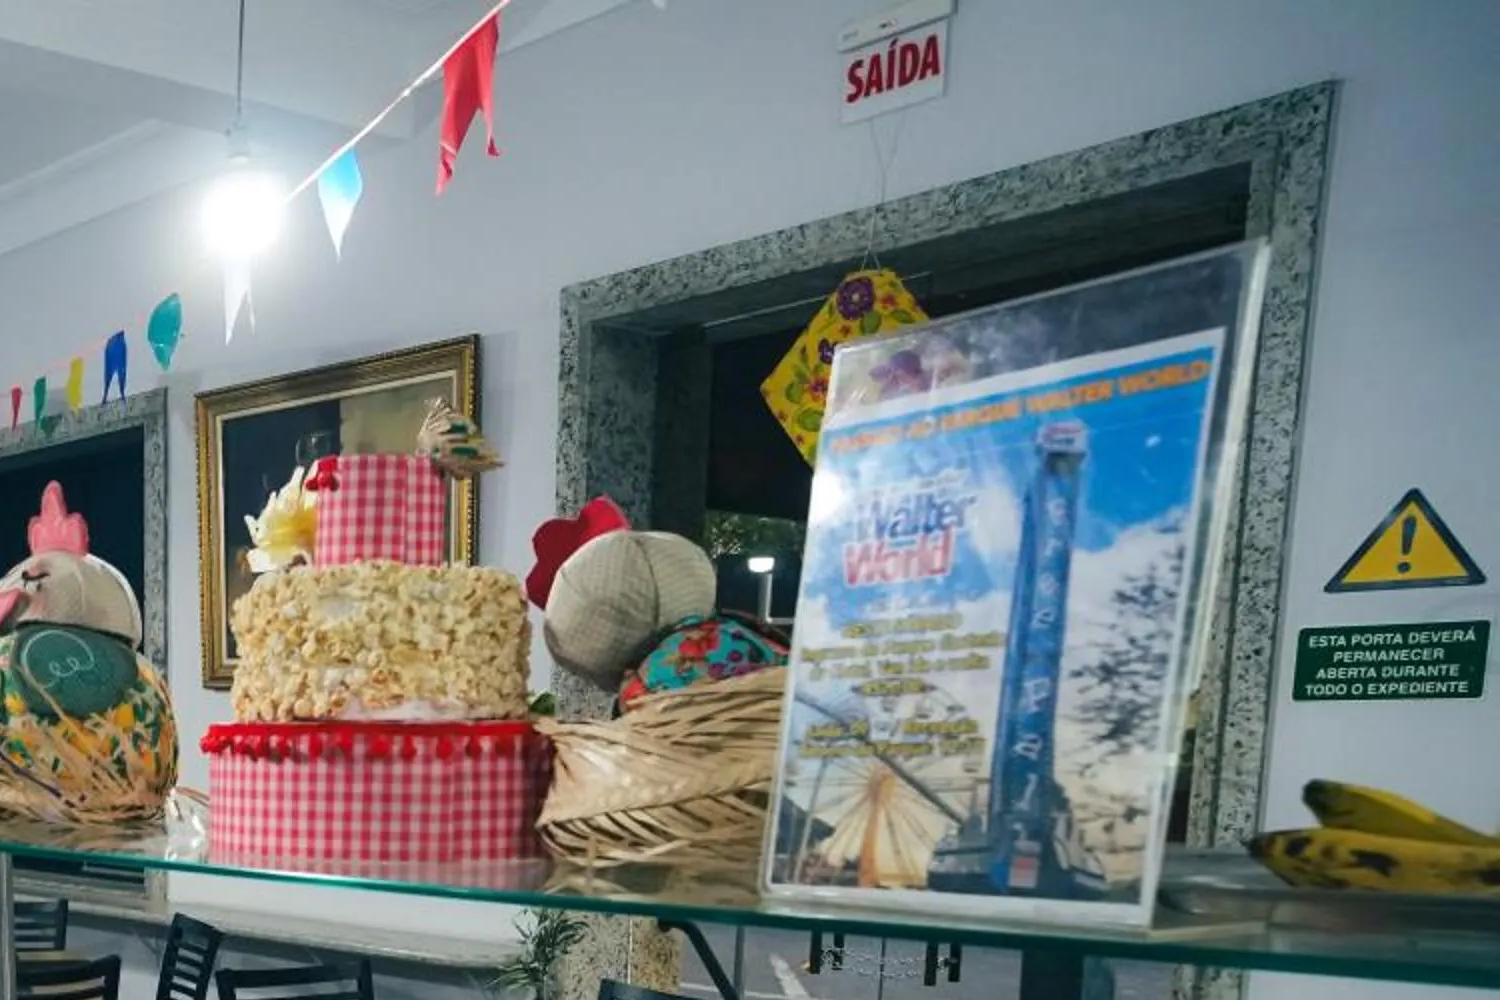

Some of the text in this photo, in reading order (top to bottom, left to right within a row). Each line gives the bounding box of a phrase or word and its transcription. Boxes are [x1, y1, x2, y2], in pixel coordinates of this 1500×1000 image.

[846, 32, 940, 104] SAÍDA
[844, 525, 953, 587] World
[1308, 626, 1477, 649] ESTA PORTA DEVERÁ
[1333, 647, 1445, 663] PERMANECER
[1316, 663, 1461, 680] ABERTA DURANTE
[1305, 681, 1469, 697] TODO O EXPEDIENTE
